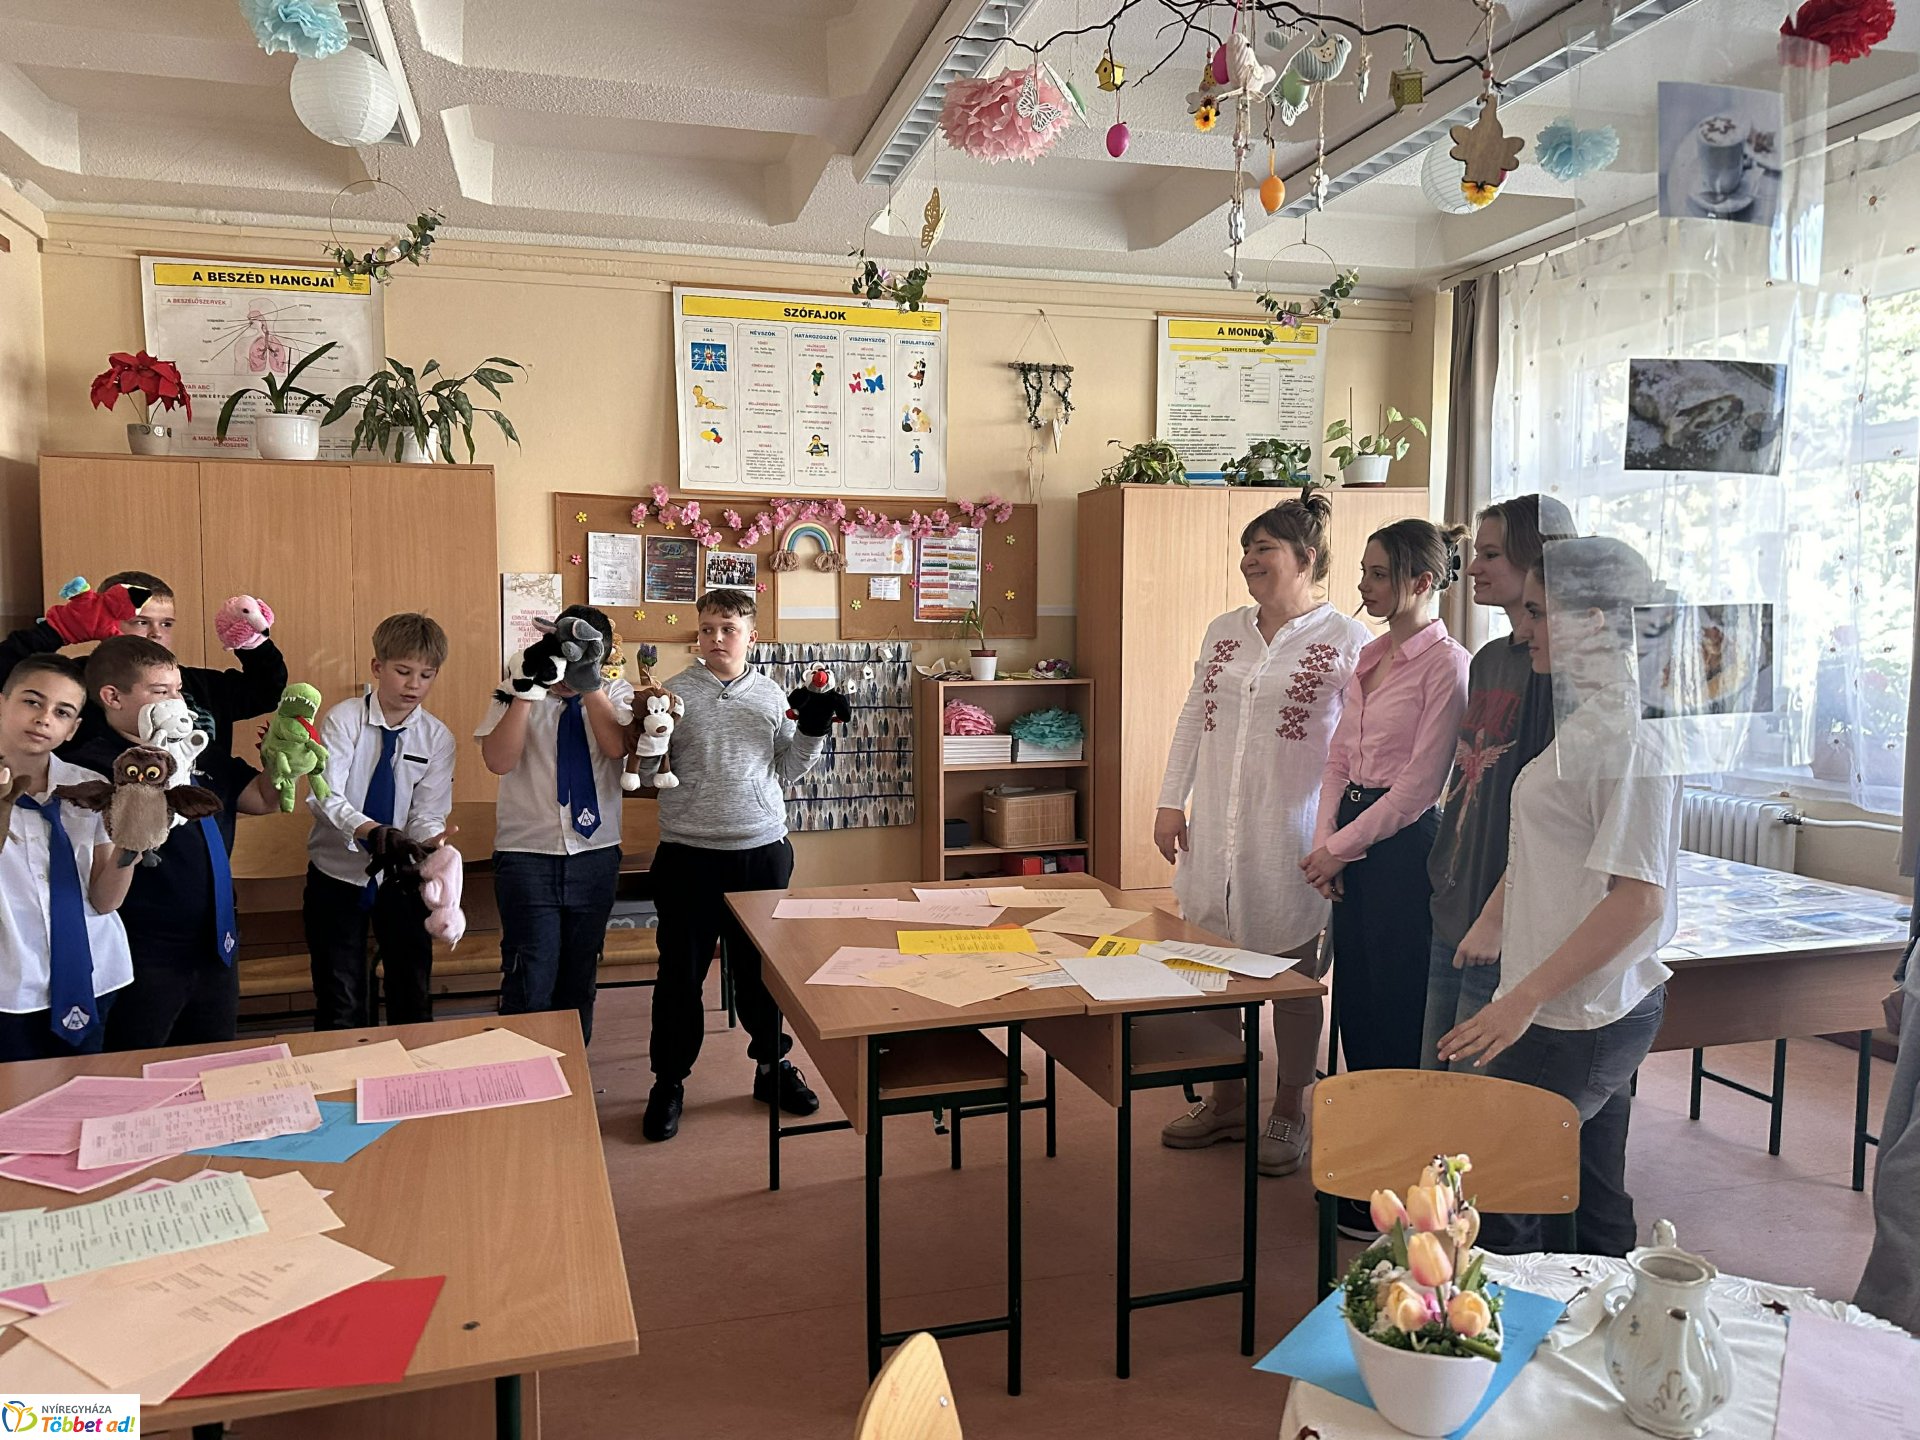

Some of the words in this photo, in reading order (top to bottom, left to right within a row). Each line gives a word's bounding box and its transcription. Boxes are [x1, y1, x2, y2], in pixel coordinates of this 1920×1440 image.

[192, 272, 203, 281] A
[207, 271, 265, 284] BESZÉD
[270, 274, 335, 288] HANGJAI
[783, 306, 847, 320] SZÓFAJOK
[1217, 327, 1225, 335] A
